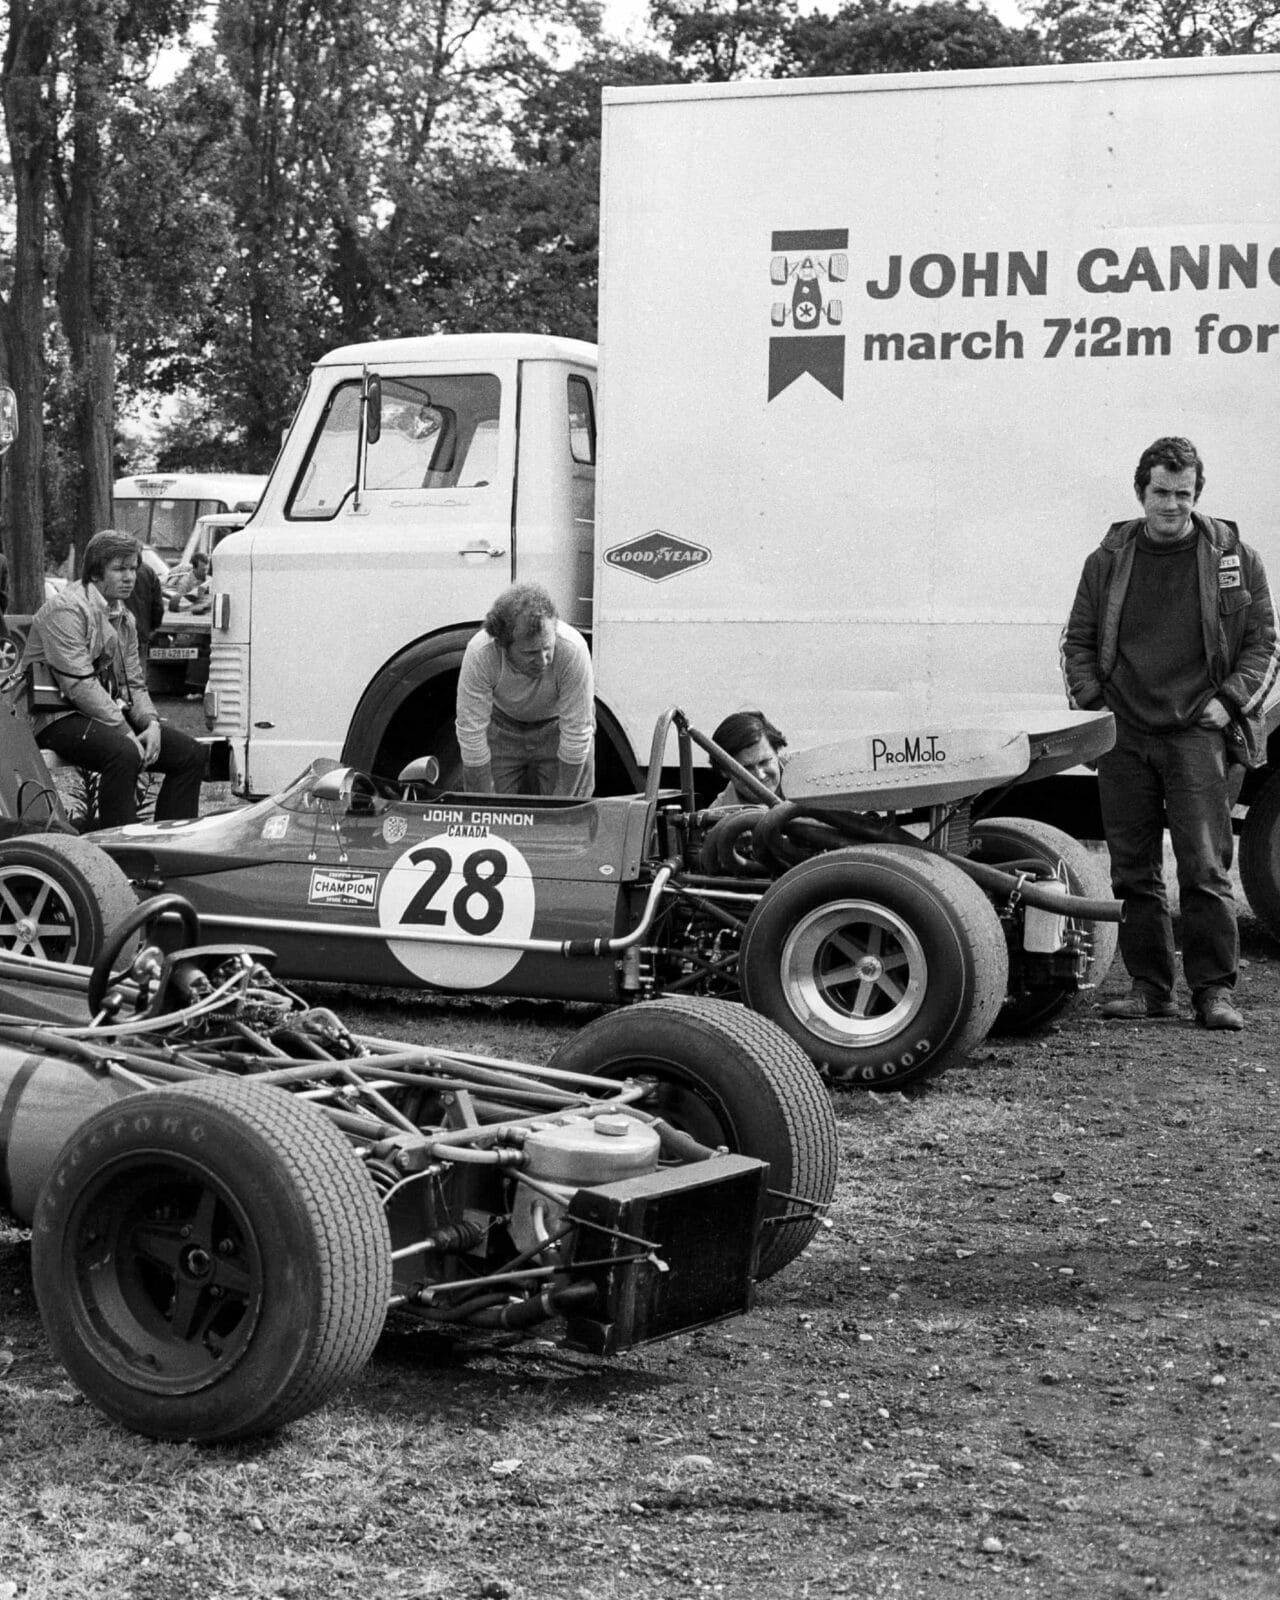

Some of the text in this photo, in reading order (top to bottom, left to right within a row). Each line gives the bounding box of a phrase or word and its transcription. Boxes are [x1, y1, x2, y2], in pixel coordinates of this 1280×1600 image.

[866, 242, 1280, 300] JOHN CANN
[864, 319, 1024, 361] march
[1195, 313, 1280, 355] for
[423, 809, 534, 826] JOHN CANNON
[447, 824, 489, 839] CANADA
[314, 881, 373, 895] CHAMPION
[398, 846, 508, 937] 28
